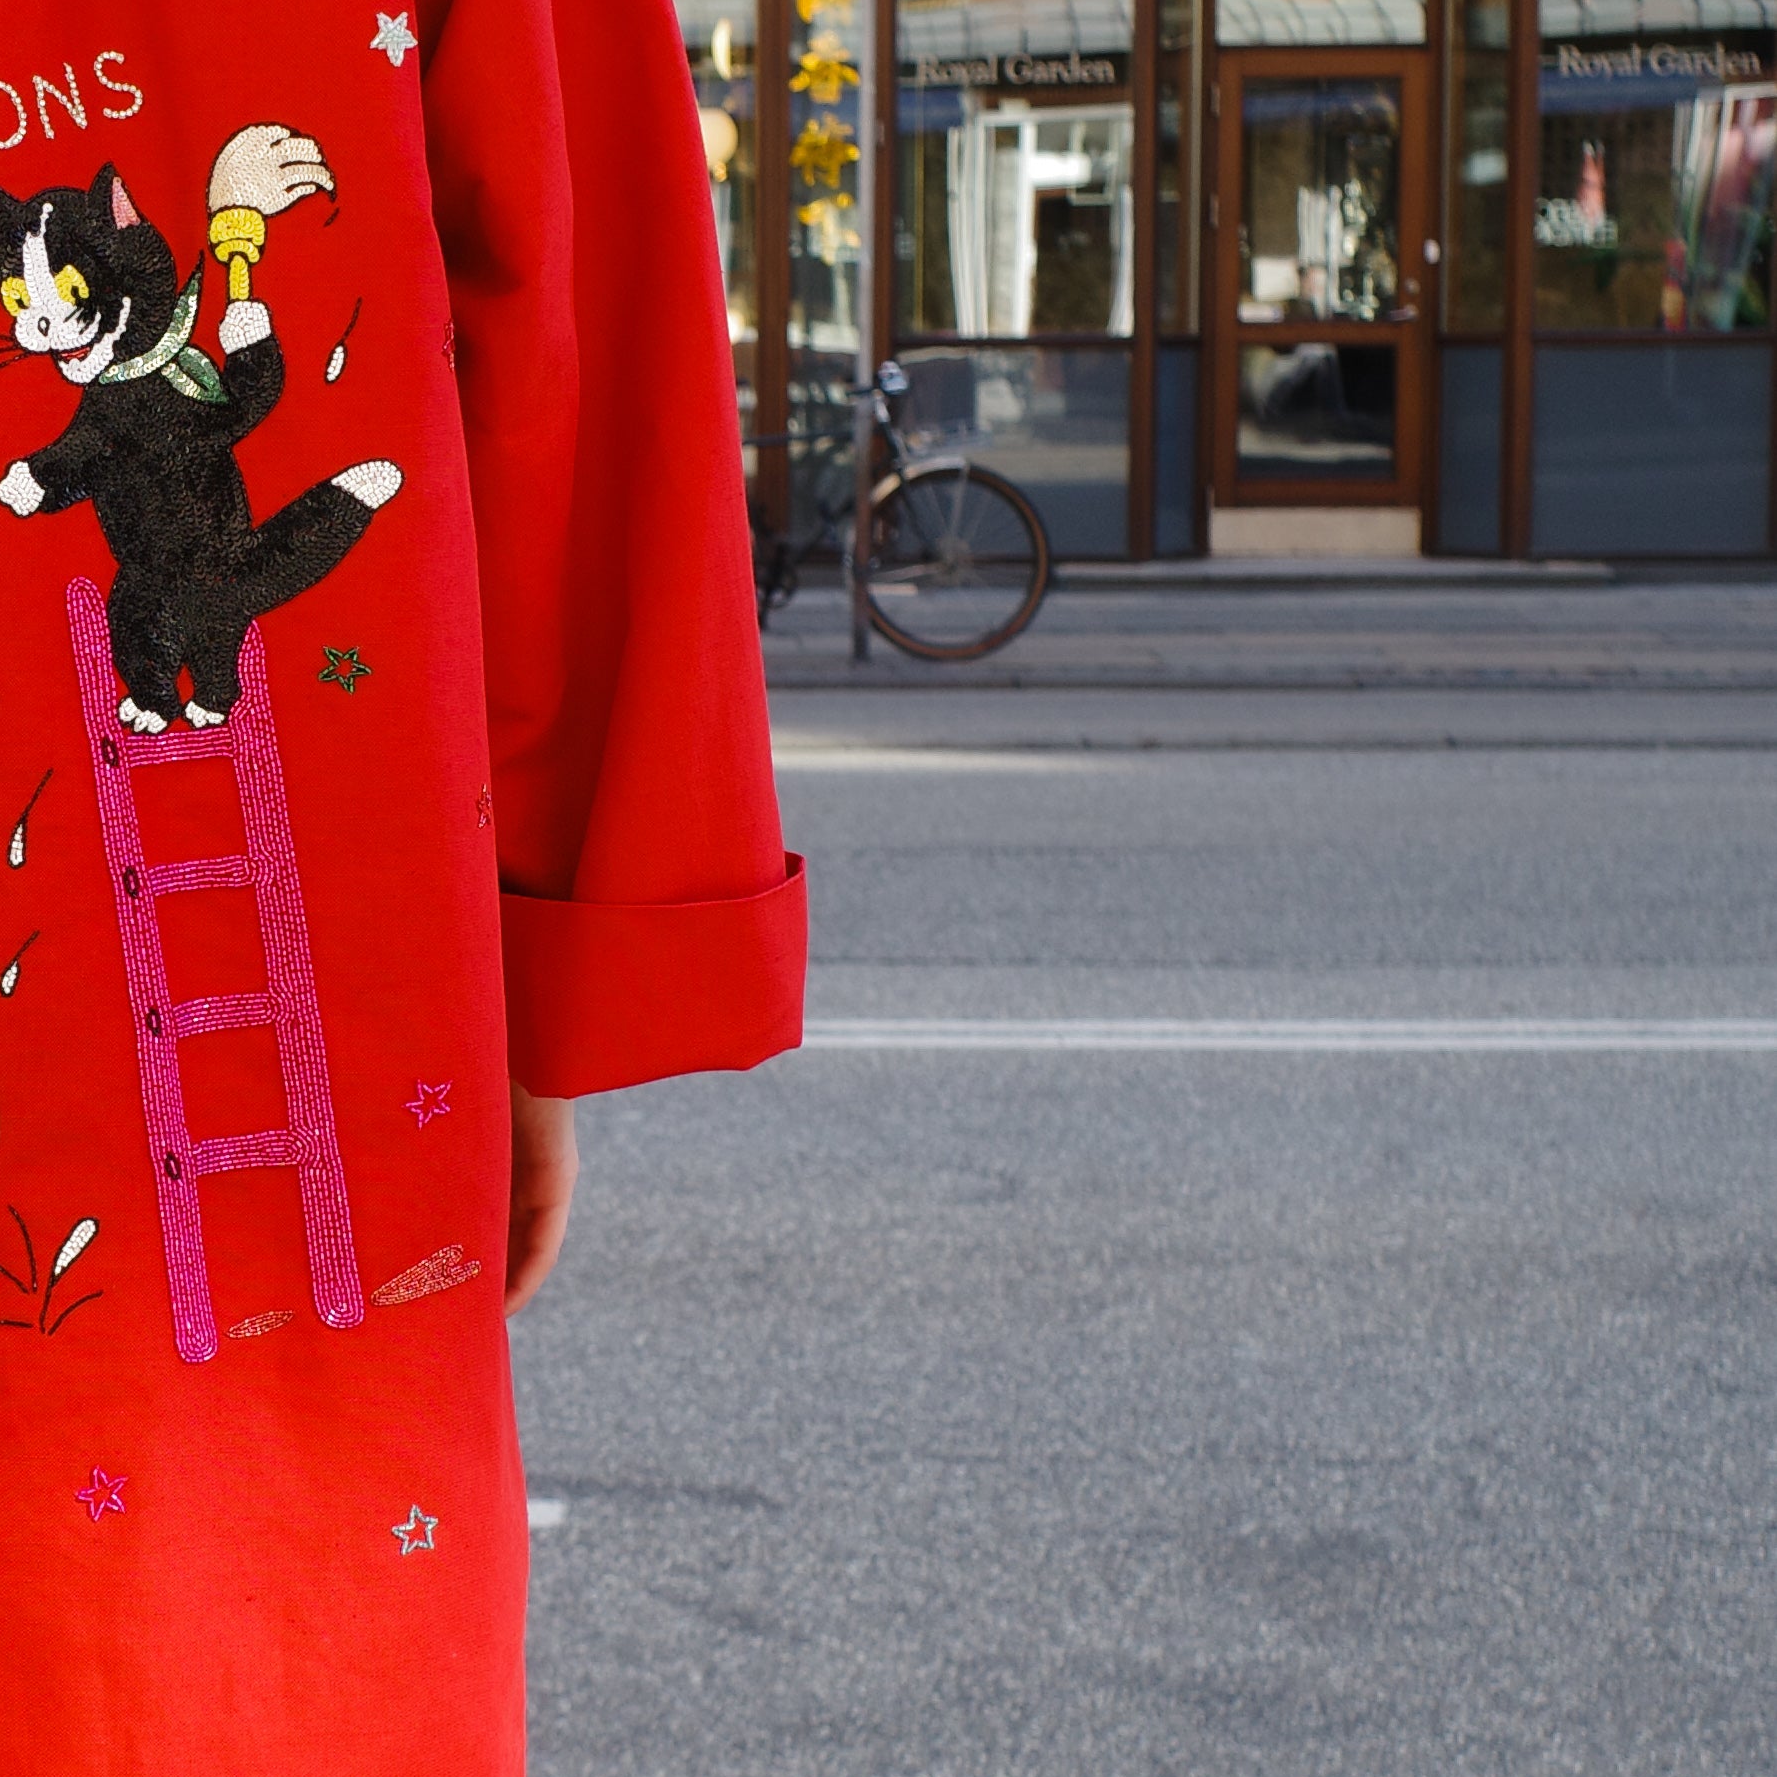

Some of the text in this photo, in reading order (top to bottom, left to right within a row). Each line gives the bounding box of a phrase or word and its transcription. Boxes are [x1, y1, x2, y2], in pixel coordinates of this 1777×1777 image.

[915, 51, 1116, 86] Royal Garden
[1558, 40, 1762, 80] Royal Garden
